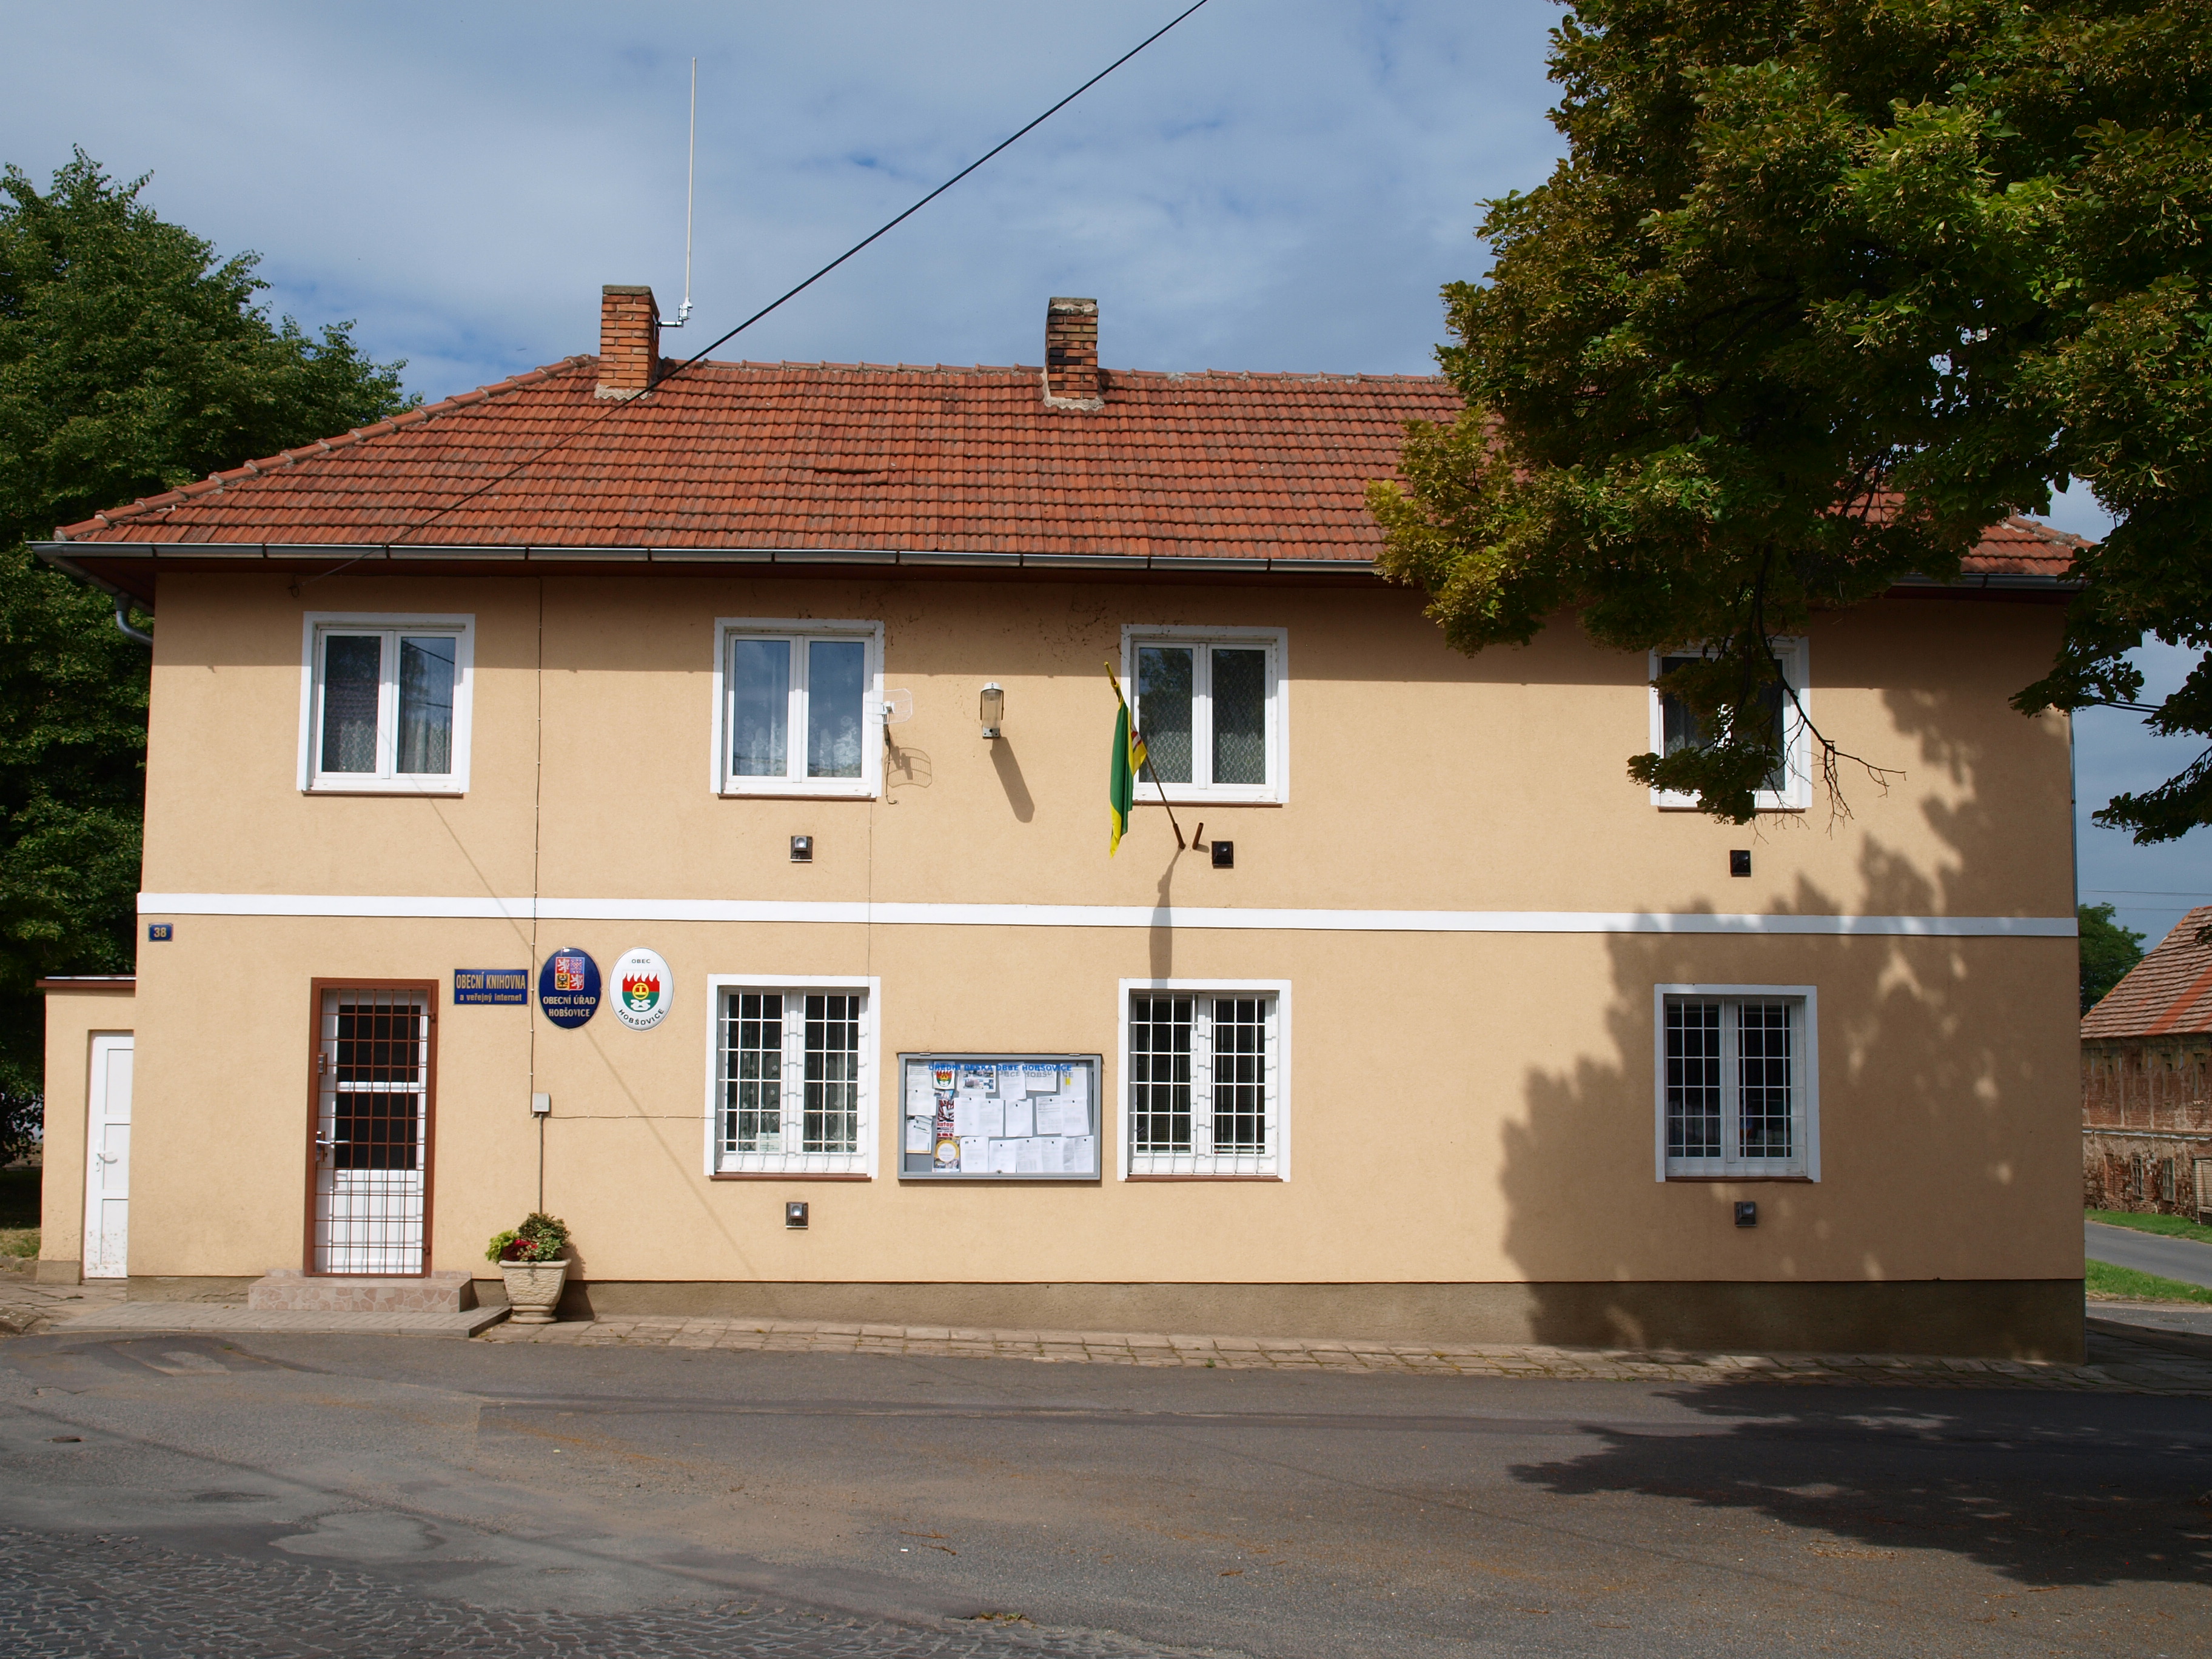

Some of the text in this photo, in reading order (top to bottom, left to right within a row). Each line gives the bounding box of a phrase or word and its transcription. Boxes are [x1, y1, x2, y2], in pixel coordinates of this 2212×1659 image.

[154, 927, 167, 937] 38
[456, 971, 526, 989] OBECNÍ KNIHOVNA
[466, 993, 492, 1002] veřejný
[543, 994, 596, 1005] OBECNÍ ÚŘAD
[548, 1007, 590, 1017] HOBŠOVICE
[618, 1008, 665, 1025] HOBŠOVICE
